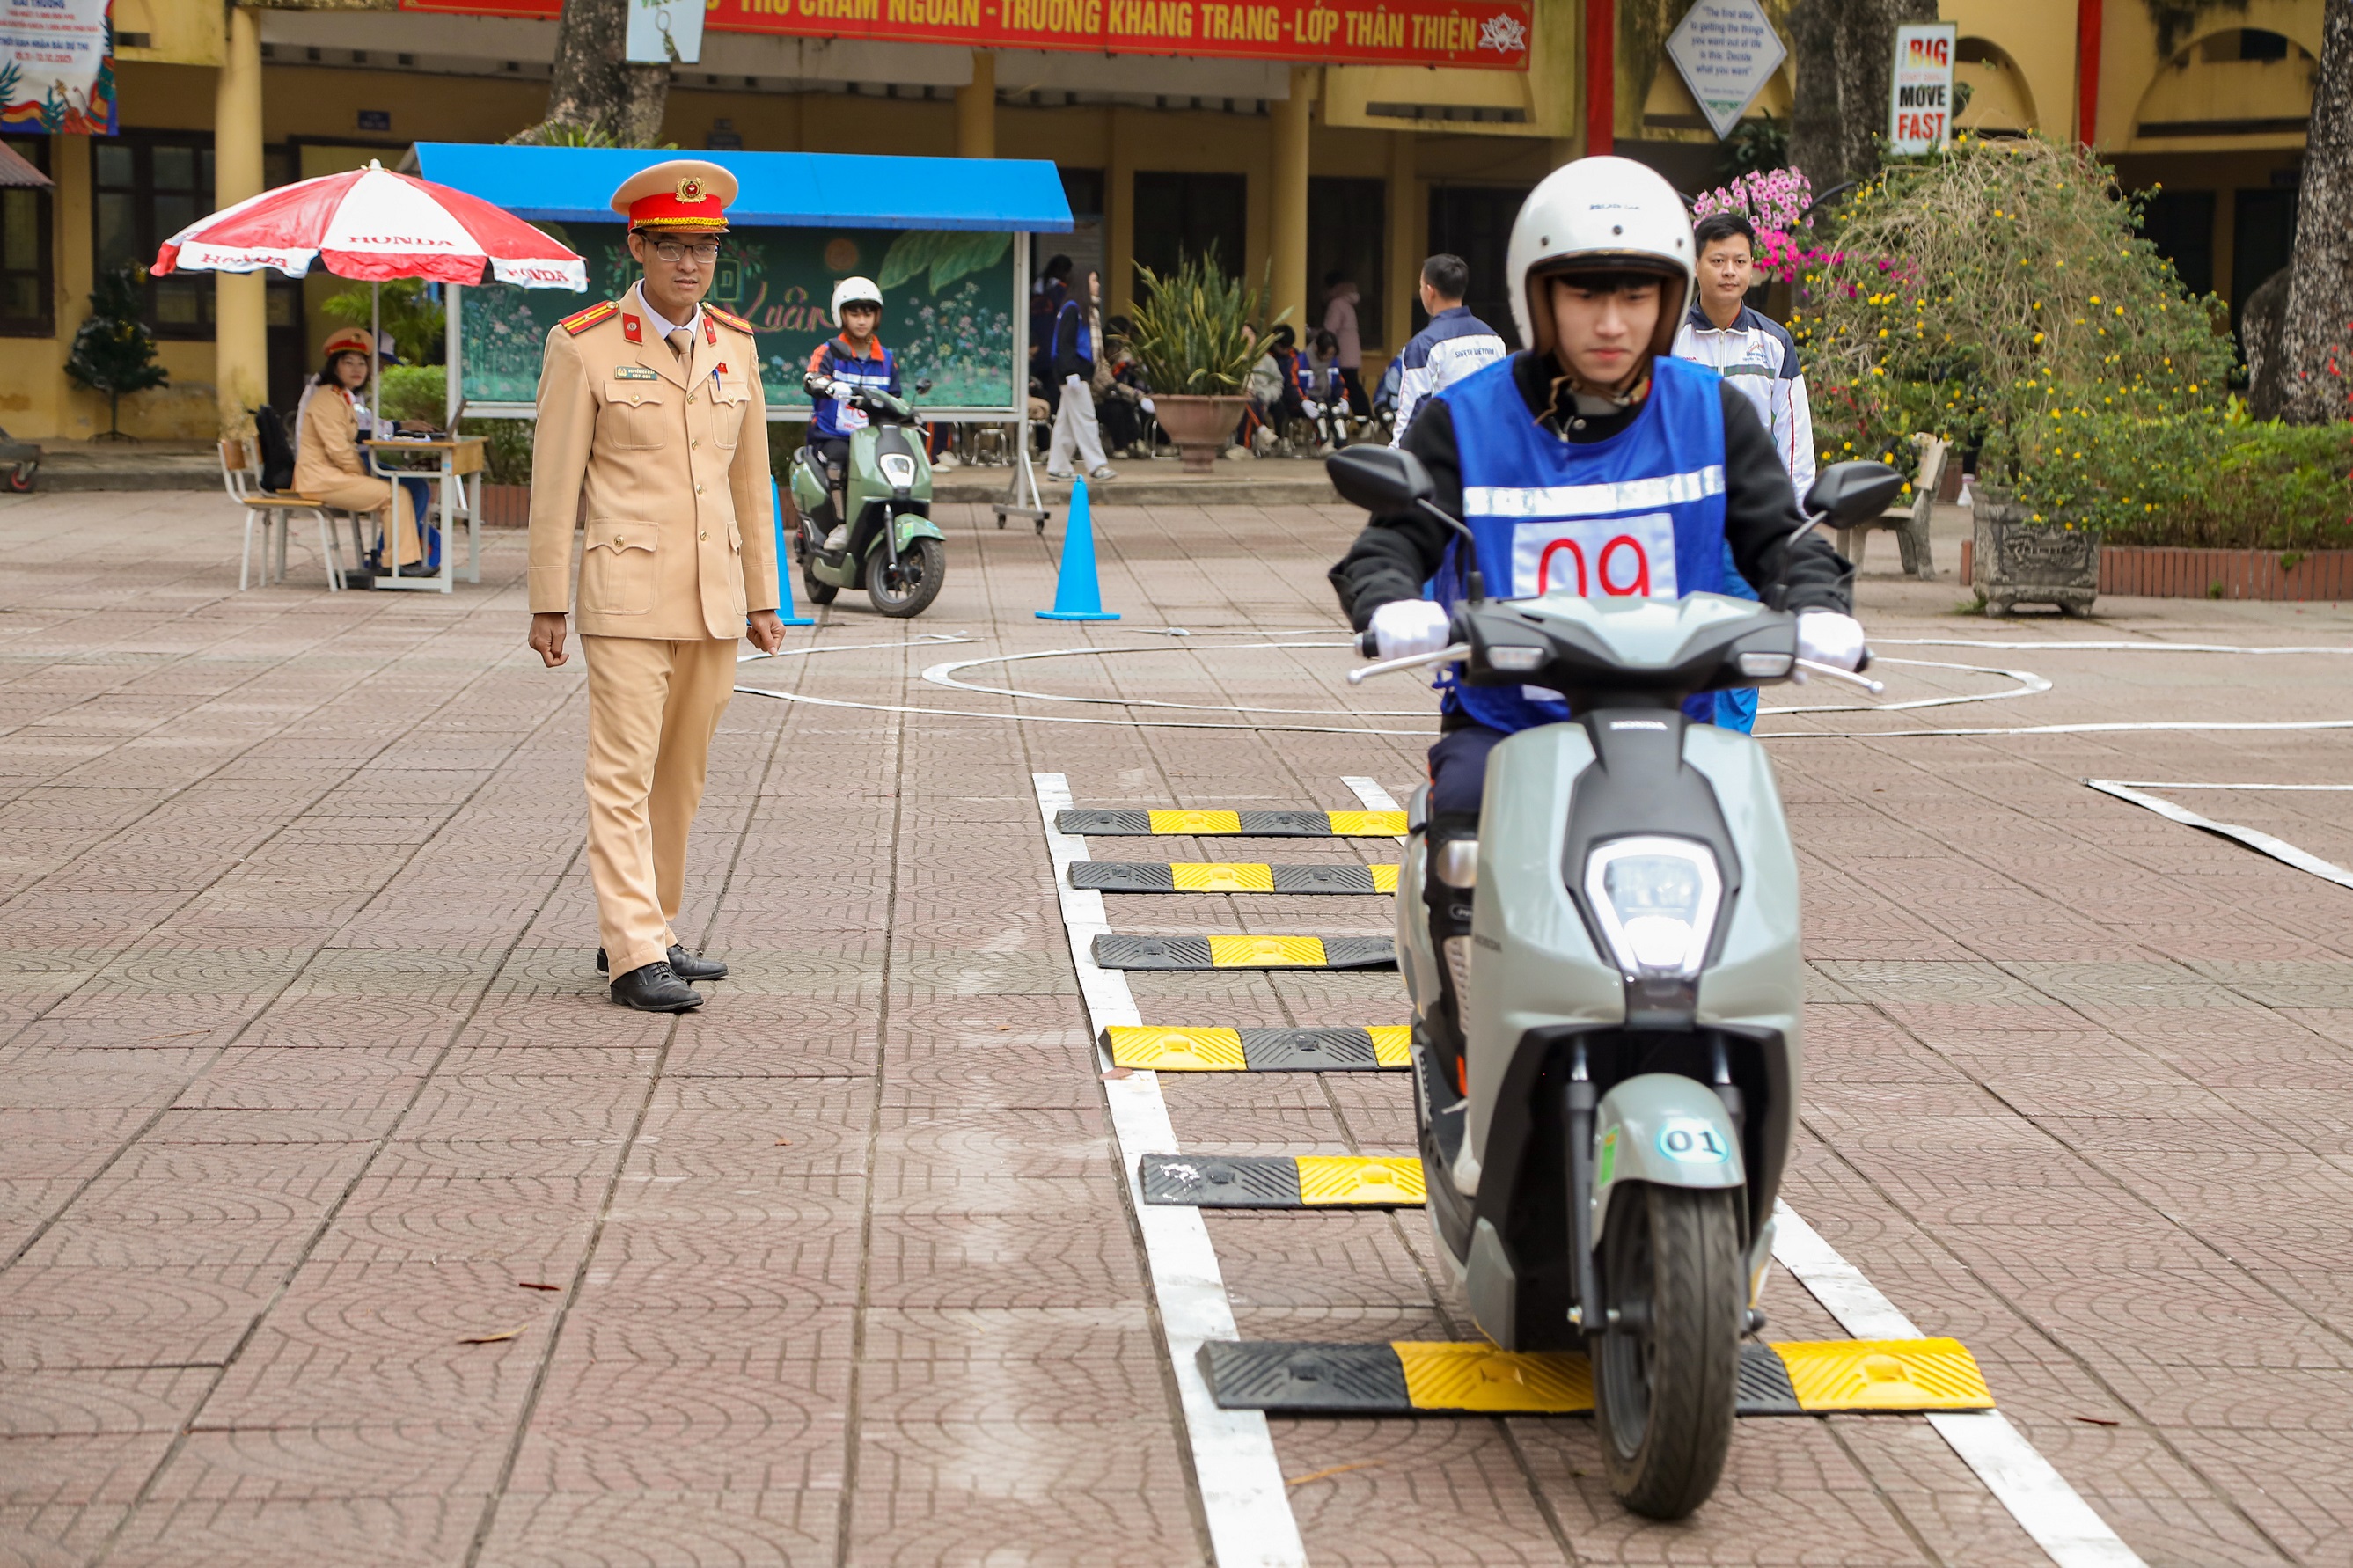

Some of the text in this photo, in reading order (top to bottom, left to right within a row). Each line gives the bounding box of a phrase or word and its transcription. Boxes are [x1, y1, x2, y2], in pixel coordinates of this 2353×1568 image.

[1720, 7, 1736, 18] first
[1738, 11, 1754, 21] step
[1108, 0, 1192, 37] KHANG
[1201, 4, 1279, 41] TRANG
[1294, 0, 1339, 44] LỚP
[1345, 4, 1404, 48] THÂN
[1411, 9, 1477, 59] THIỆN
[1690, 21, 1764, 35] to getting the things
[1727, 39, 1739, 48] out
[1741, 39, 1748, 48] of
[1751, 40, 1762, 48] life
[1907, 38, 1948, 68] BIG
[1726, 51, 1752, 62] Decide
[1696, 64, 1713, 74] what
[1715, 66, 1727, 77] you
[1899, 84, 1946, 108] MOVE
[1898, 113, 1946, 140] FAST
[348, 236, 454, 246] HONDA
[1538, 533, 1651, 597] 09
[1668, 1130, 1723, 1154] 01
